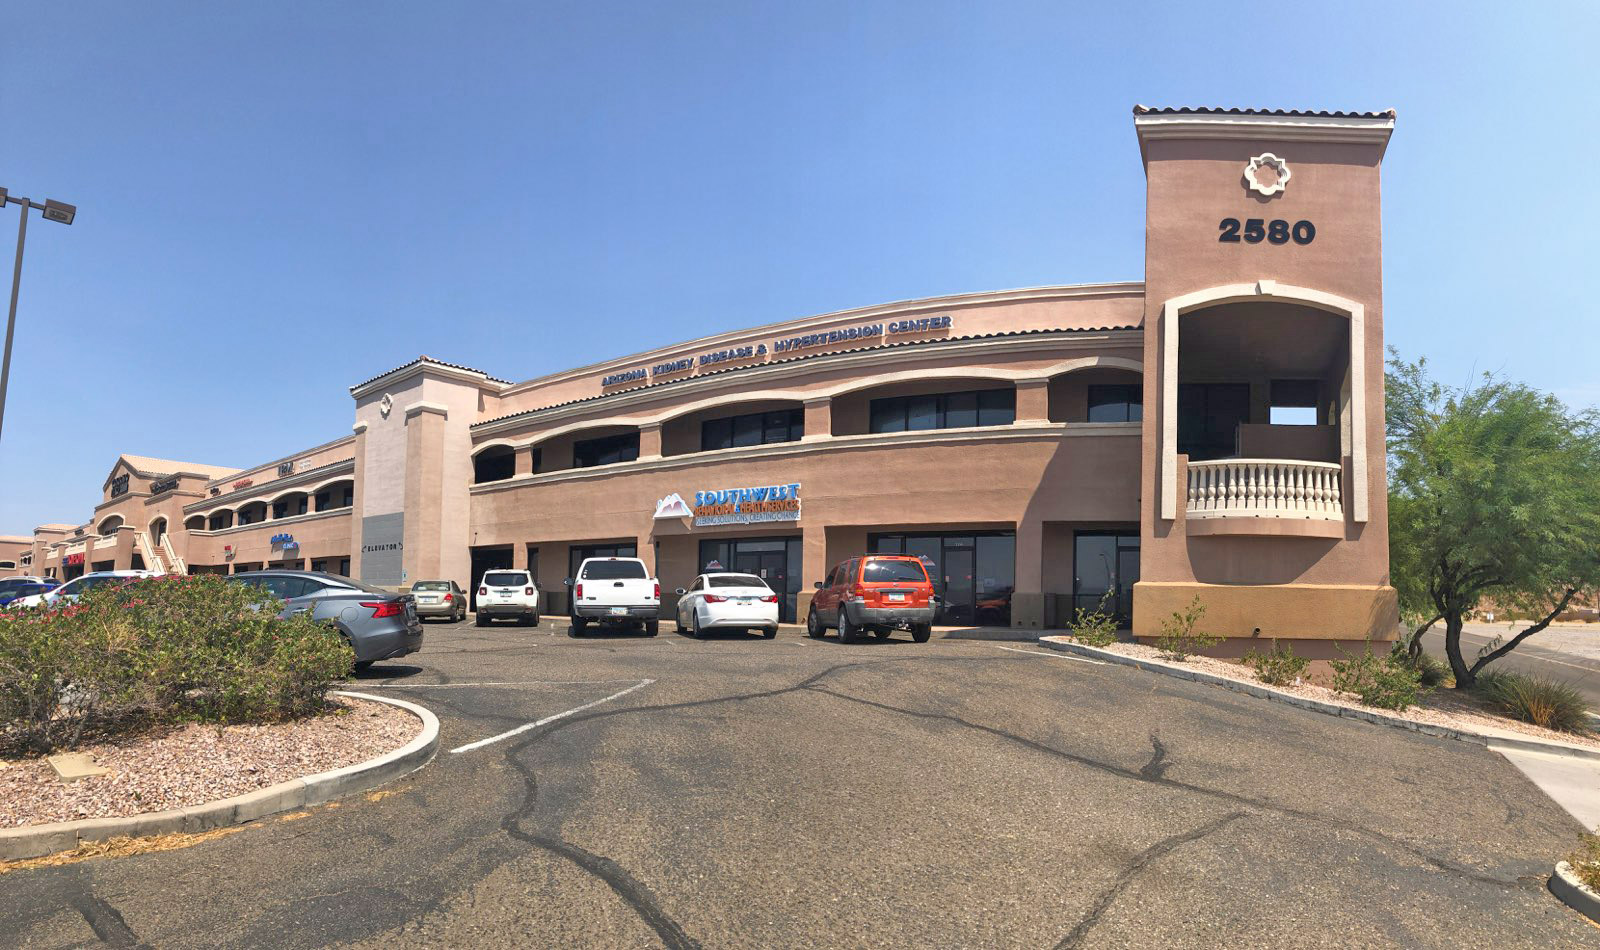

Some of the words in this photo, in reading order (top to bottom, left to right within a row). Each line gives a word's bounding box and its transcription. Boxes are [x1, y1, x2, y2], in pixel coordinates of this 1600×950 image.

[1218, 217, 1316, 245] 2580
[601, 368, 648, 387] ARIZONA
[652, 357, 695, 377] KIDNEY
[699, 344, 756, 366] DISEASE
[757, 343, 768, 356] &
[774, 323, 885, 352] HYPERTENSION
[888, 315, 953, 333] CENTER
[694, 484, 800, 507] SOUTHWEST
[740, 501, 768, 513] HEALTH
[767, 499, 800, 512] SERVICES
[696, 517, 717, 526] SEEKING
[749, 512, 777, 522] CREATING
[776, 511, 800, 521] CHANGE
[367, 543, 397, 552] ELEVATOR
